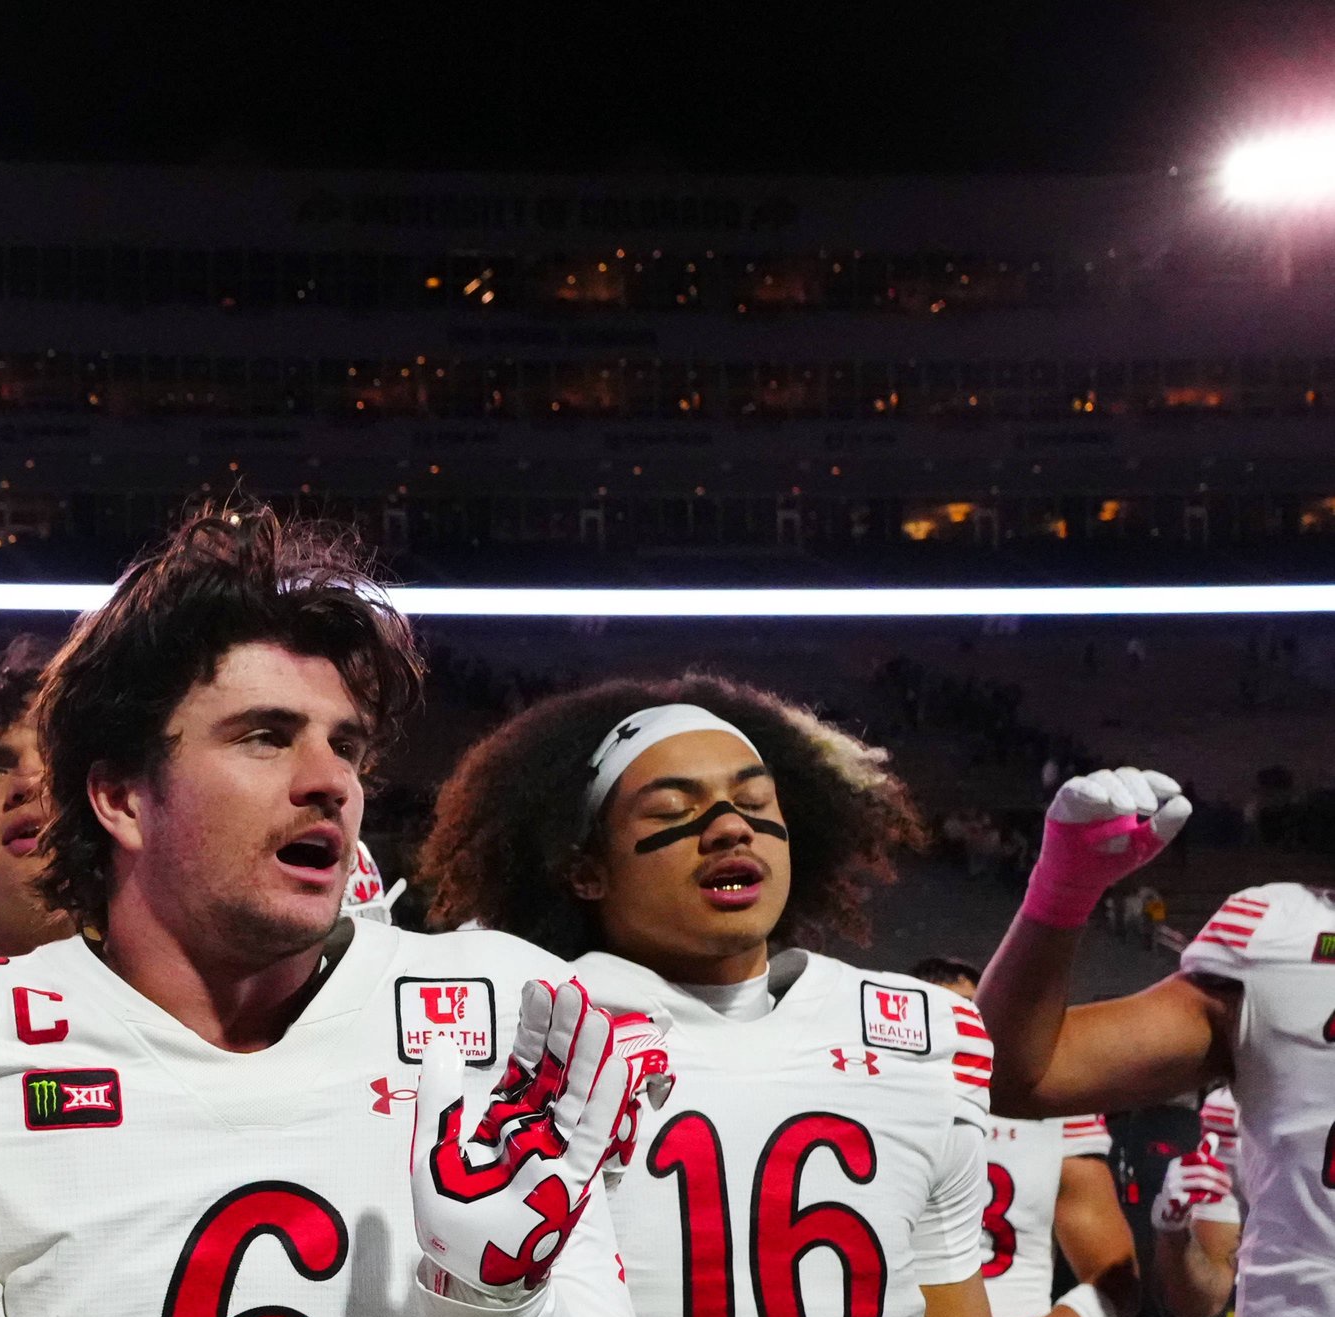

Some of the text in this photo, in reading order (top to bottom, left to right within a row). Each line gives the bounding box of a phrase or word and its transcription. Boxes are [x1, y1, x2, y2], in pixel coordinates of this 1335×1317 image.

[12, 987, 69, 1046] C
[869, 1022, 923, 1041] HEALTH
[64, 1084, 112, 1108] XII
